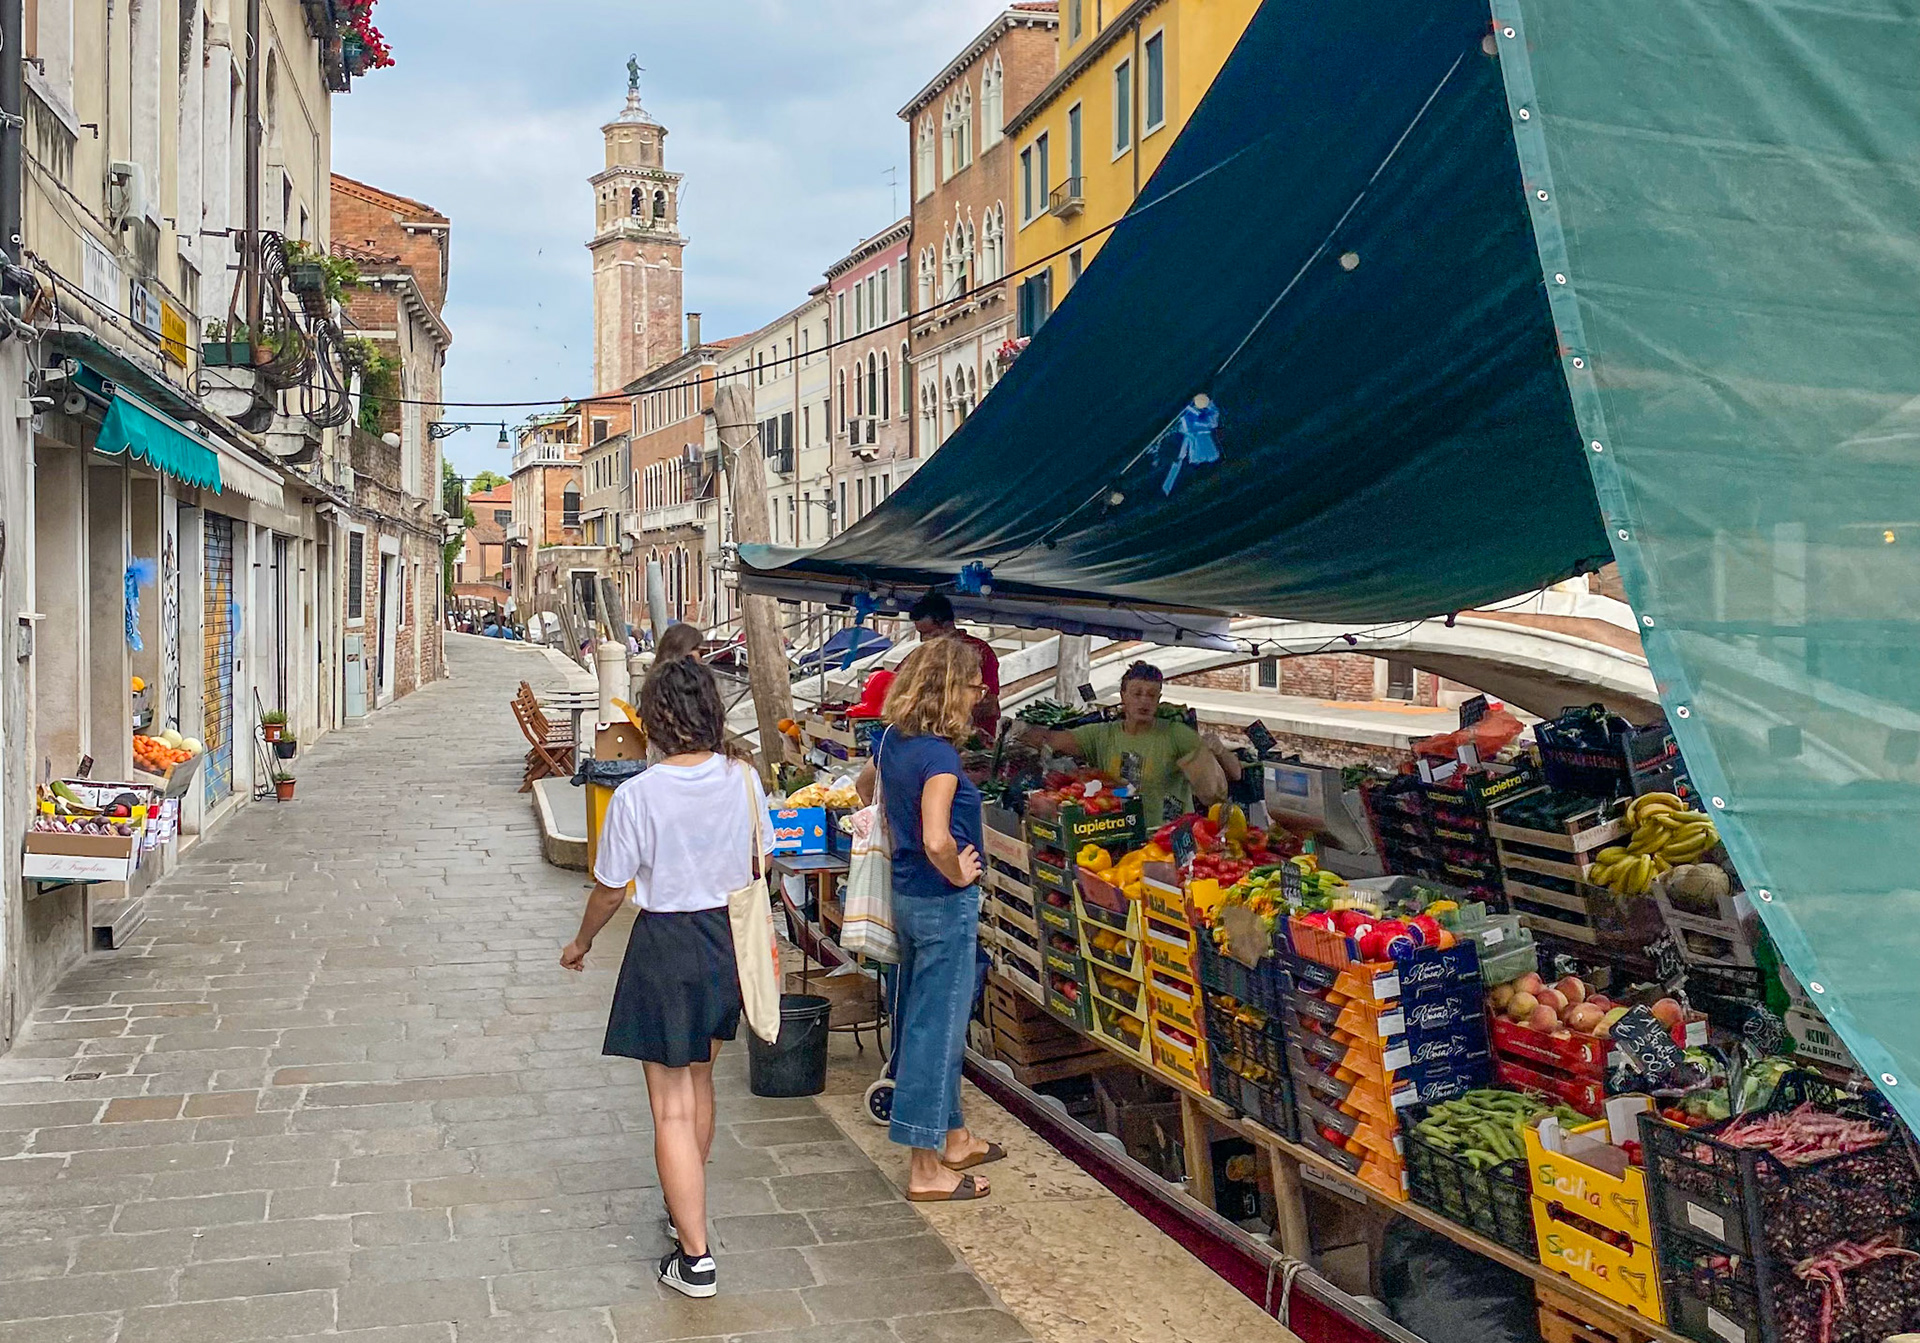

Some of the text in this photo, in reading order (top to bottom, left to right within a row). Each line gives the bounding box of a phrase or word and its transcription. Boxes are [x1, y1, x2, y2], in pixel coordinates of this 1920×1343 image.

[1634, 1004, 1668, 1040] FAVE
[1538, 1164, 1602, 1209] Sicilia
[1545, 1233, 1609, 1282] Sicilia
